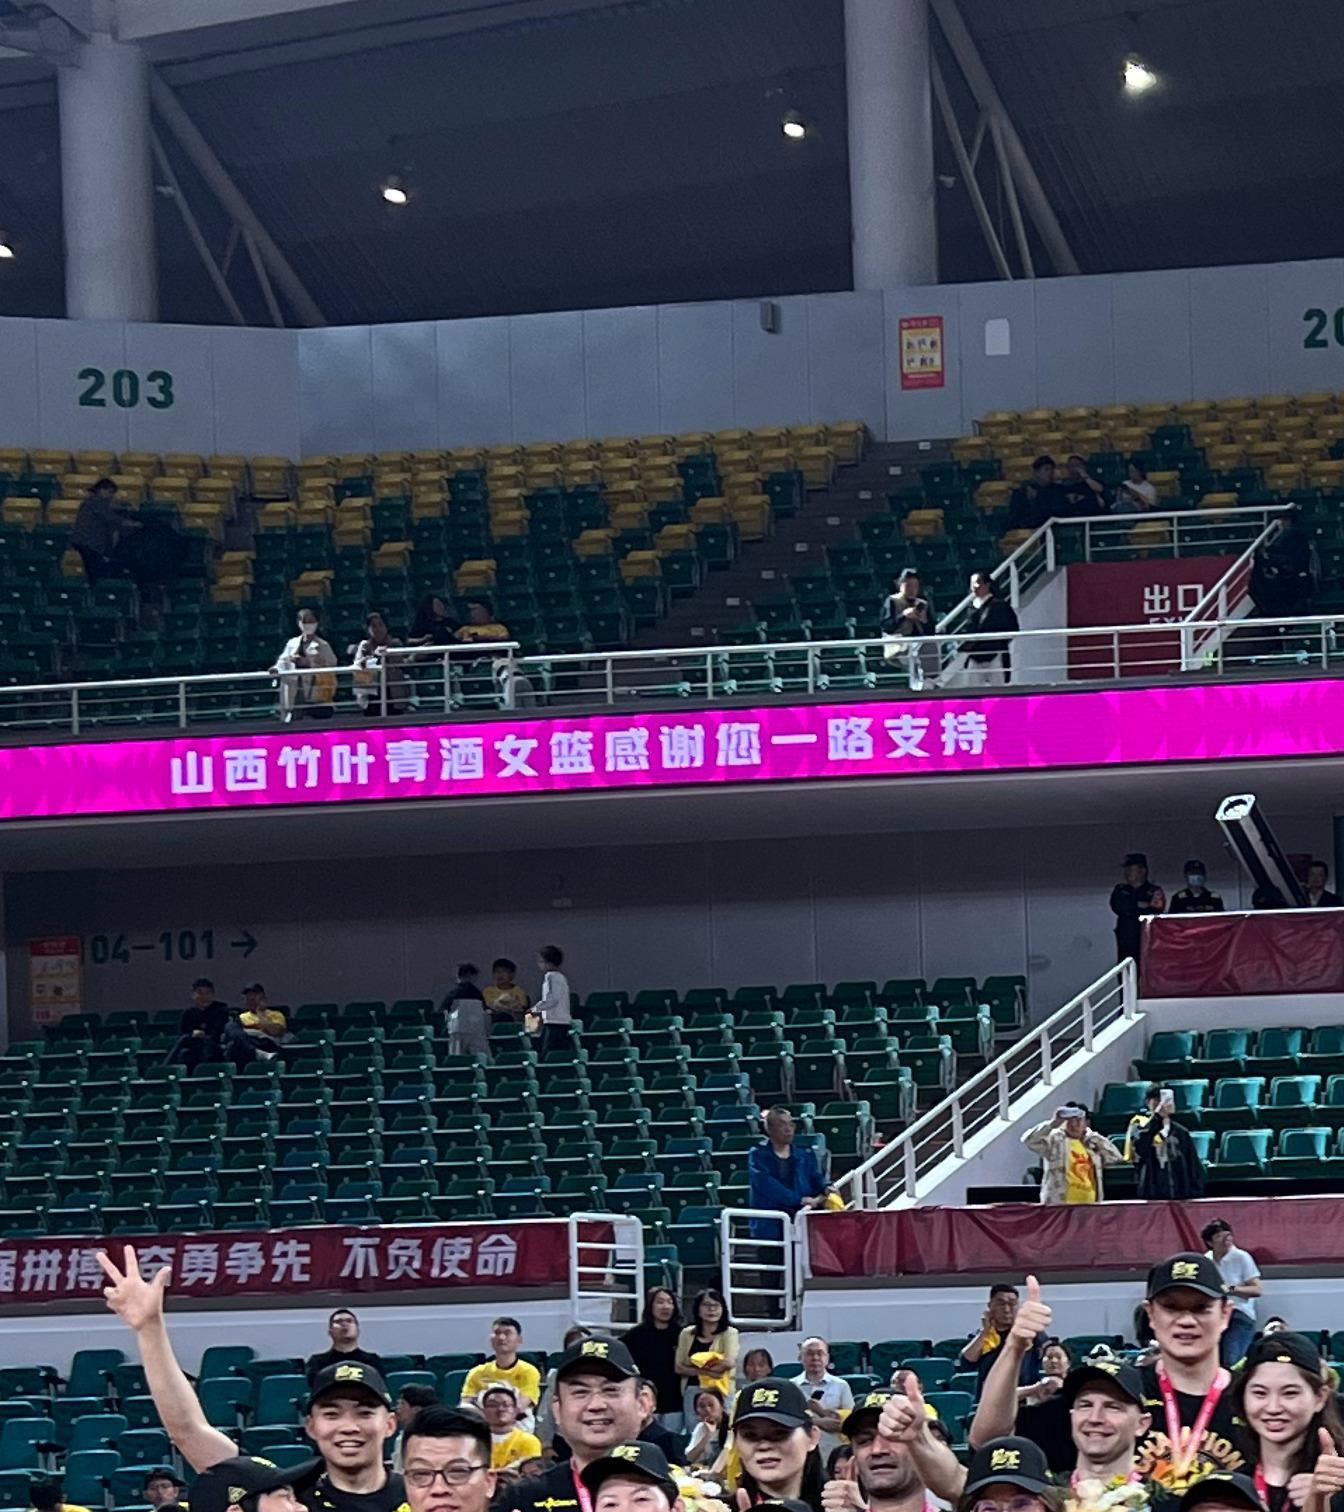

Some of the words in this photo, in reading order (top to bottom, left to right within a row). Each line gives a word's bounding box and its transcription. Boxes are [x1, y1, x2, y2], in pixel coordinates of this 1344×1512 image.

[78, 367, 174, 410] 203
[1143, 584, 1204, 614] 出口
[170, 711, 988, 795] 山西竹叶青酒女篮感谢您一路支持
[137, 1236, 310, 1287] 奋勇争先
[343, 1233, 517, 1281] 不负使命
